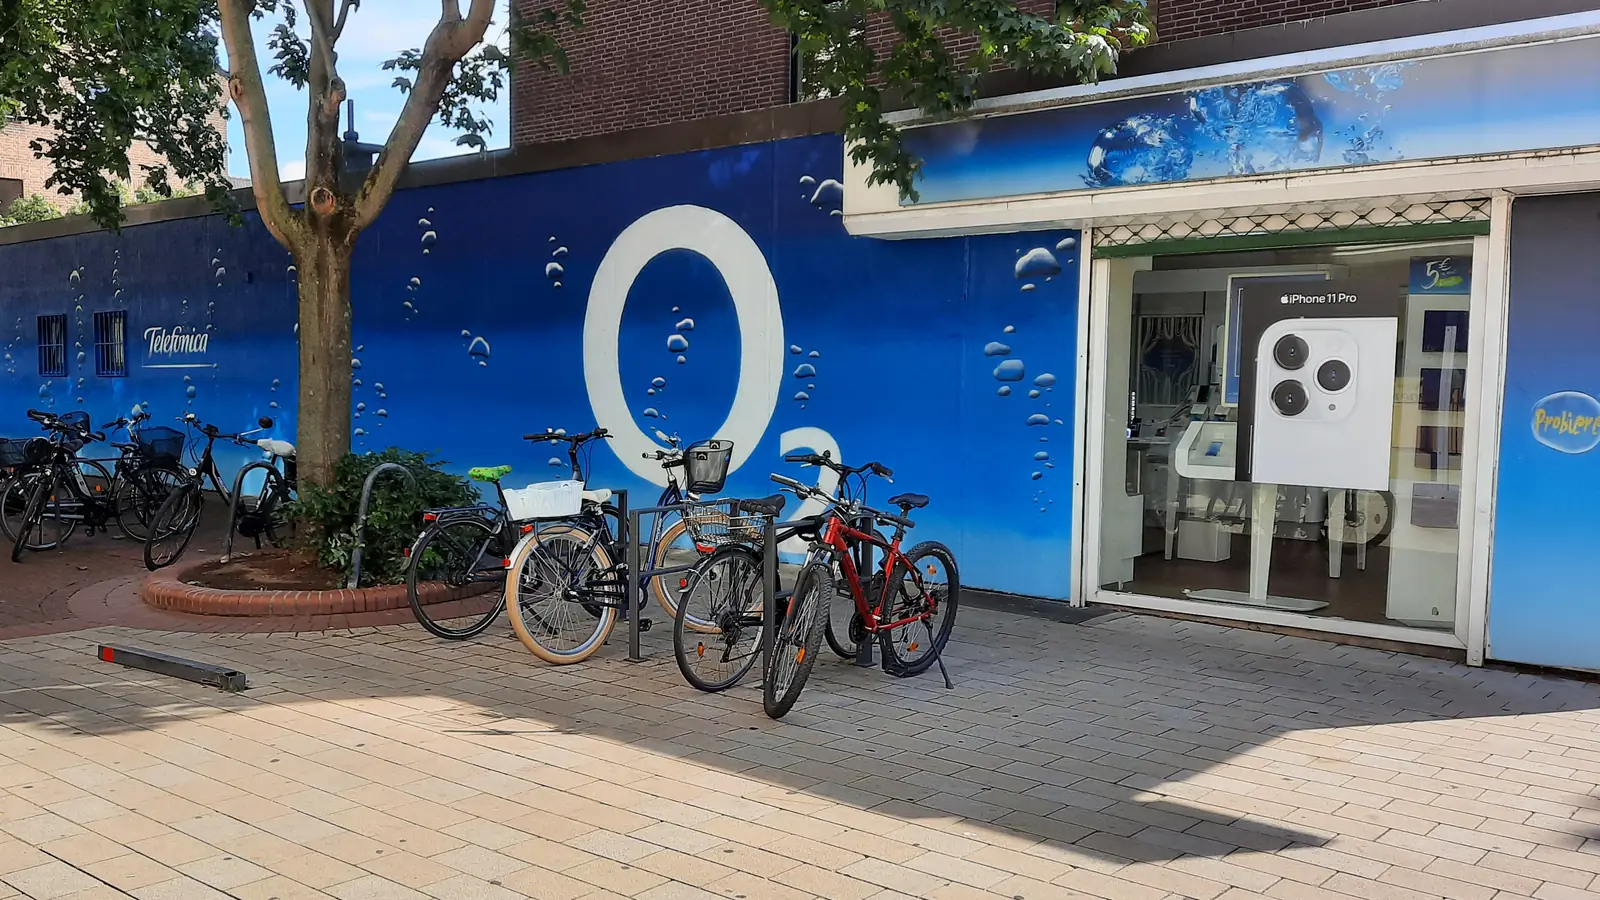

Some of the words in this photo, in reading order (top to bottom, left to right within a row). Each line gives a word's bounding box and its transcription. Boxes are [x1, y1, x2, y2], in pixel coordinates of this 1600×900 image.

[1289, 294, 1326, 304] iPhone
[1326, 293, 1336, 303] 11
[1338, 293, 1357, 303] Pro
